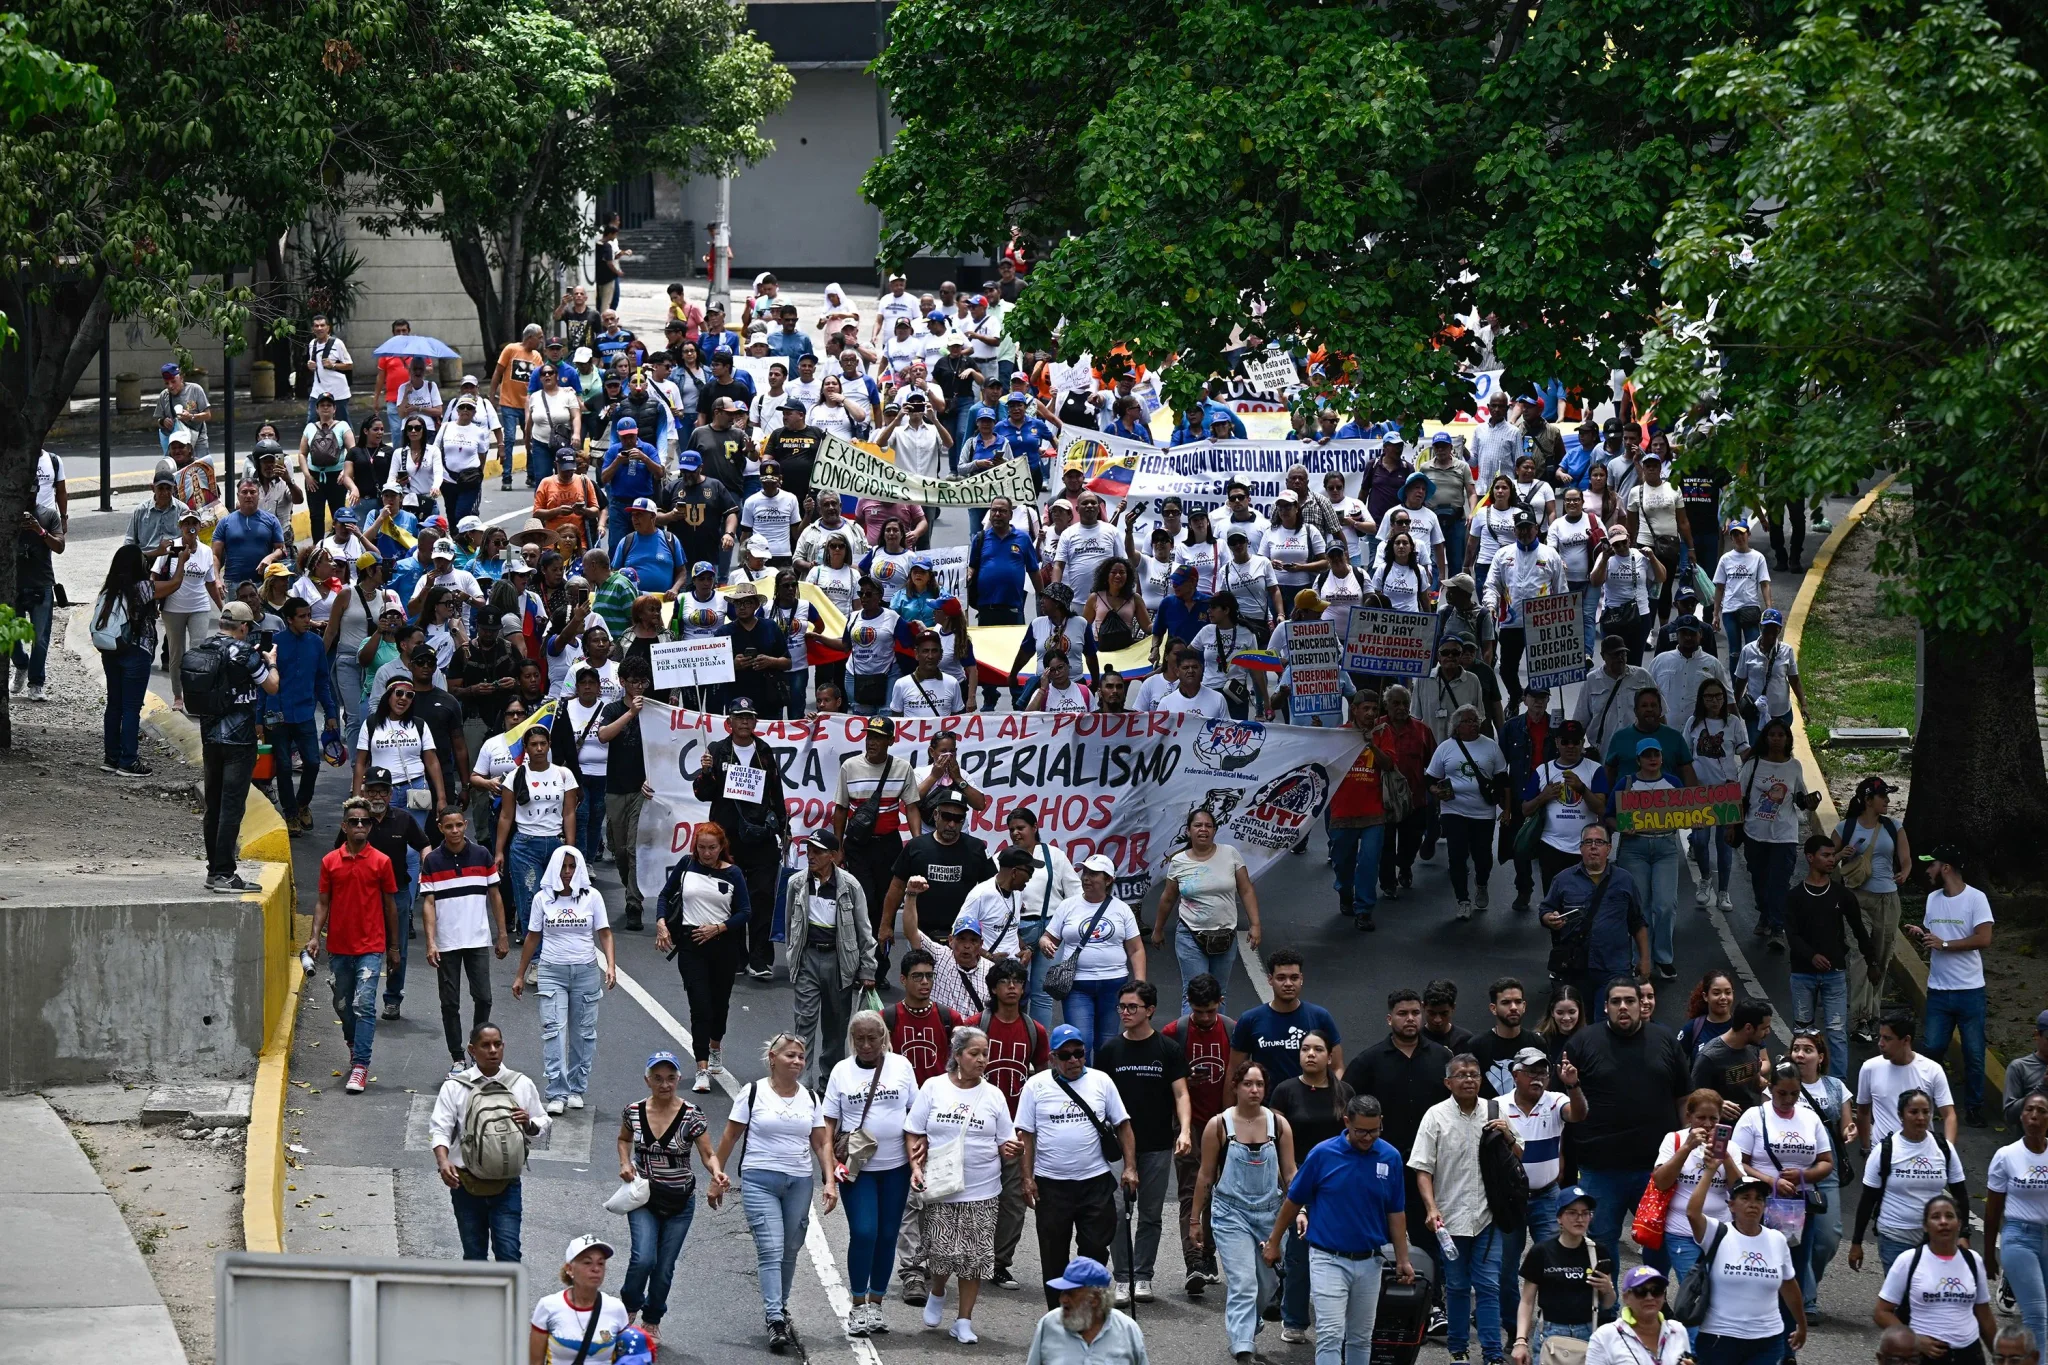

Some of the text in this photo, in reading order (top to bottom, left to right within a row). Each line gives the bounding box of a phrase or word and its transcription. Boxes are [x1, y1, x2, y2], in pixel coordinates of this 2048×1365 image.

[724, 440, 738, 459] P
[825, 438, 907, 483] EXIGIMOS
[1139, 448, 1207, 476] FEDERACIÓN
[1208, 450, 1283, 472] VENEZOLANA
[1302, 450, 1365, 473] MAESTROS
[812, 460, 1036, 504] CONDICIONES LABORALES
[941, 556, 962, 564] DIGNAS
[948, 569, 960, 597] YA
[1525, 594, 1578, 614] RESCATE Y
[1359, 611, 1428, 626] SIN SALARIO
[1533, 608, 1575, 627] RESPETO
[1293, 623, 1329, 636] SALARIO
[1373, 625, 1414, 636] NO HAY
[1540, 624, 1574, 641] DE LOS
[1288, 636, 1336, 650] DEMOCRACIA
[1358, 634, 1423, 648] UTILIDADES
[653, 642, 726, 655] BOMBEROS JUBILADOS
[1347, 643, 1431, 659] NI VACACIONES
[1530, 638, 1579, 658] DERECHOS
[677, 656, 709, 664] SUELDOS
[1291, 652, 1336, 665] LIBERTAD Y
[1529, 652, 1582, 673] LABORALES
[657, 663, 697, 671] PENSIONES
[1292, 669, 1338, 682] SOBERANIA
[1296, 682, 1338, 695] NACIONAL
[997, 714, 1038, 740] AL
[1051, 711, 1185, 738] PODER!
[1210, 726, 1252, 745] FSM
[733, 766, 761, 775] QUIERO
[1184, 767, 1259, 781] Federación Sindical Mundial
[729, 776, 752, 785] VIEJO
[726, 788, 755, 797] HAMBRE
[1621, 782, 1742, 810] INDEXACION
[528, 808, 558, 816] LIFE
[1632, 806, 1716, 830] SALARIOS
[1230, 823, 1242, 832] DE
[1234, 832, 1244, 841] DE
[930, 866, 960, 874] PENSIONES
[930, 873, 961, 882] DIGNAS
[848, 1093, 861, 1101] Red
[1723, 1270, 1779, 1279] Venezolana
[1724, 1263, 1777, 1273] Red Sindical
